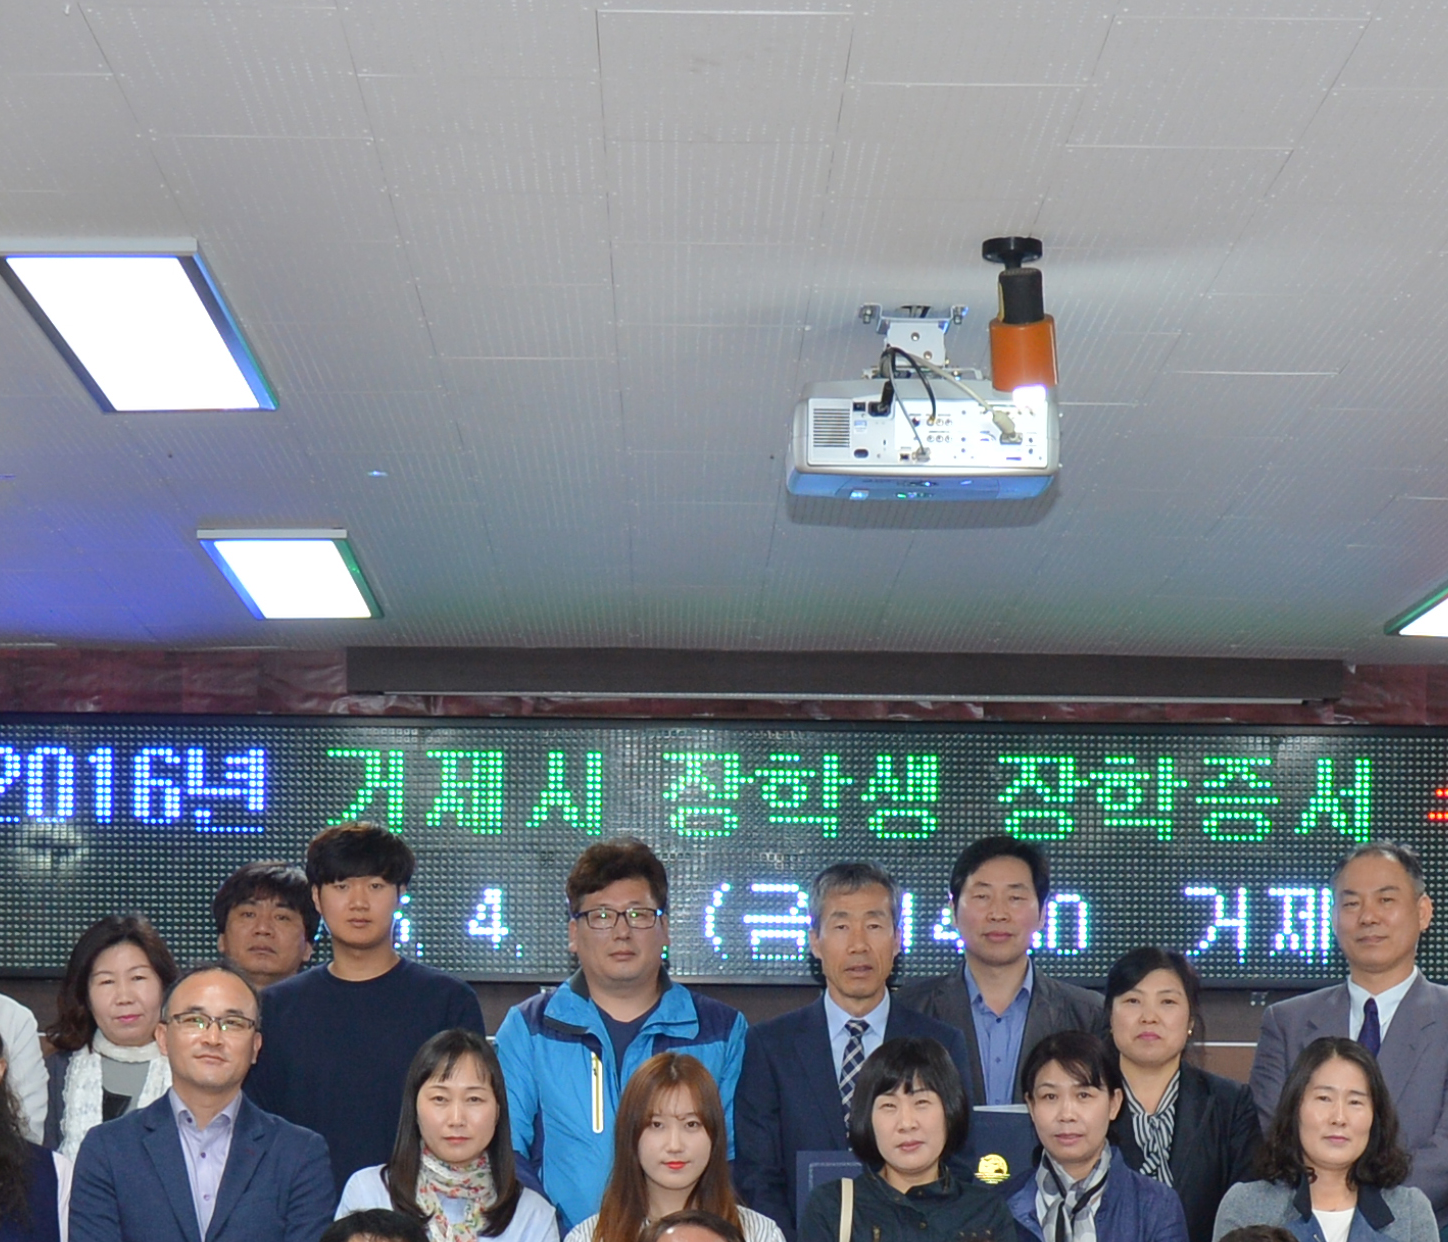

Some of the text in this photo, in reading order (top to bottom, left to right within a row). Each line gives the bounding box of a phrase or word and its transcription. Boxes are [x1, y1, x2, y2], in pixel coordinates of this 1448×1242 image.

[326, 748, 604, 836] 거제시
[661, 751, 940, 840] 장학생
[998, 755, 1372, 843] 장학증서
